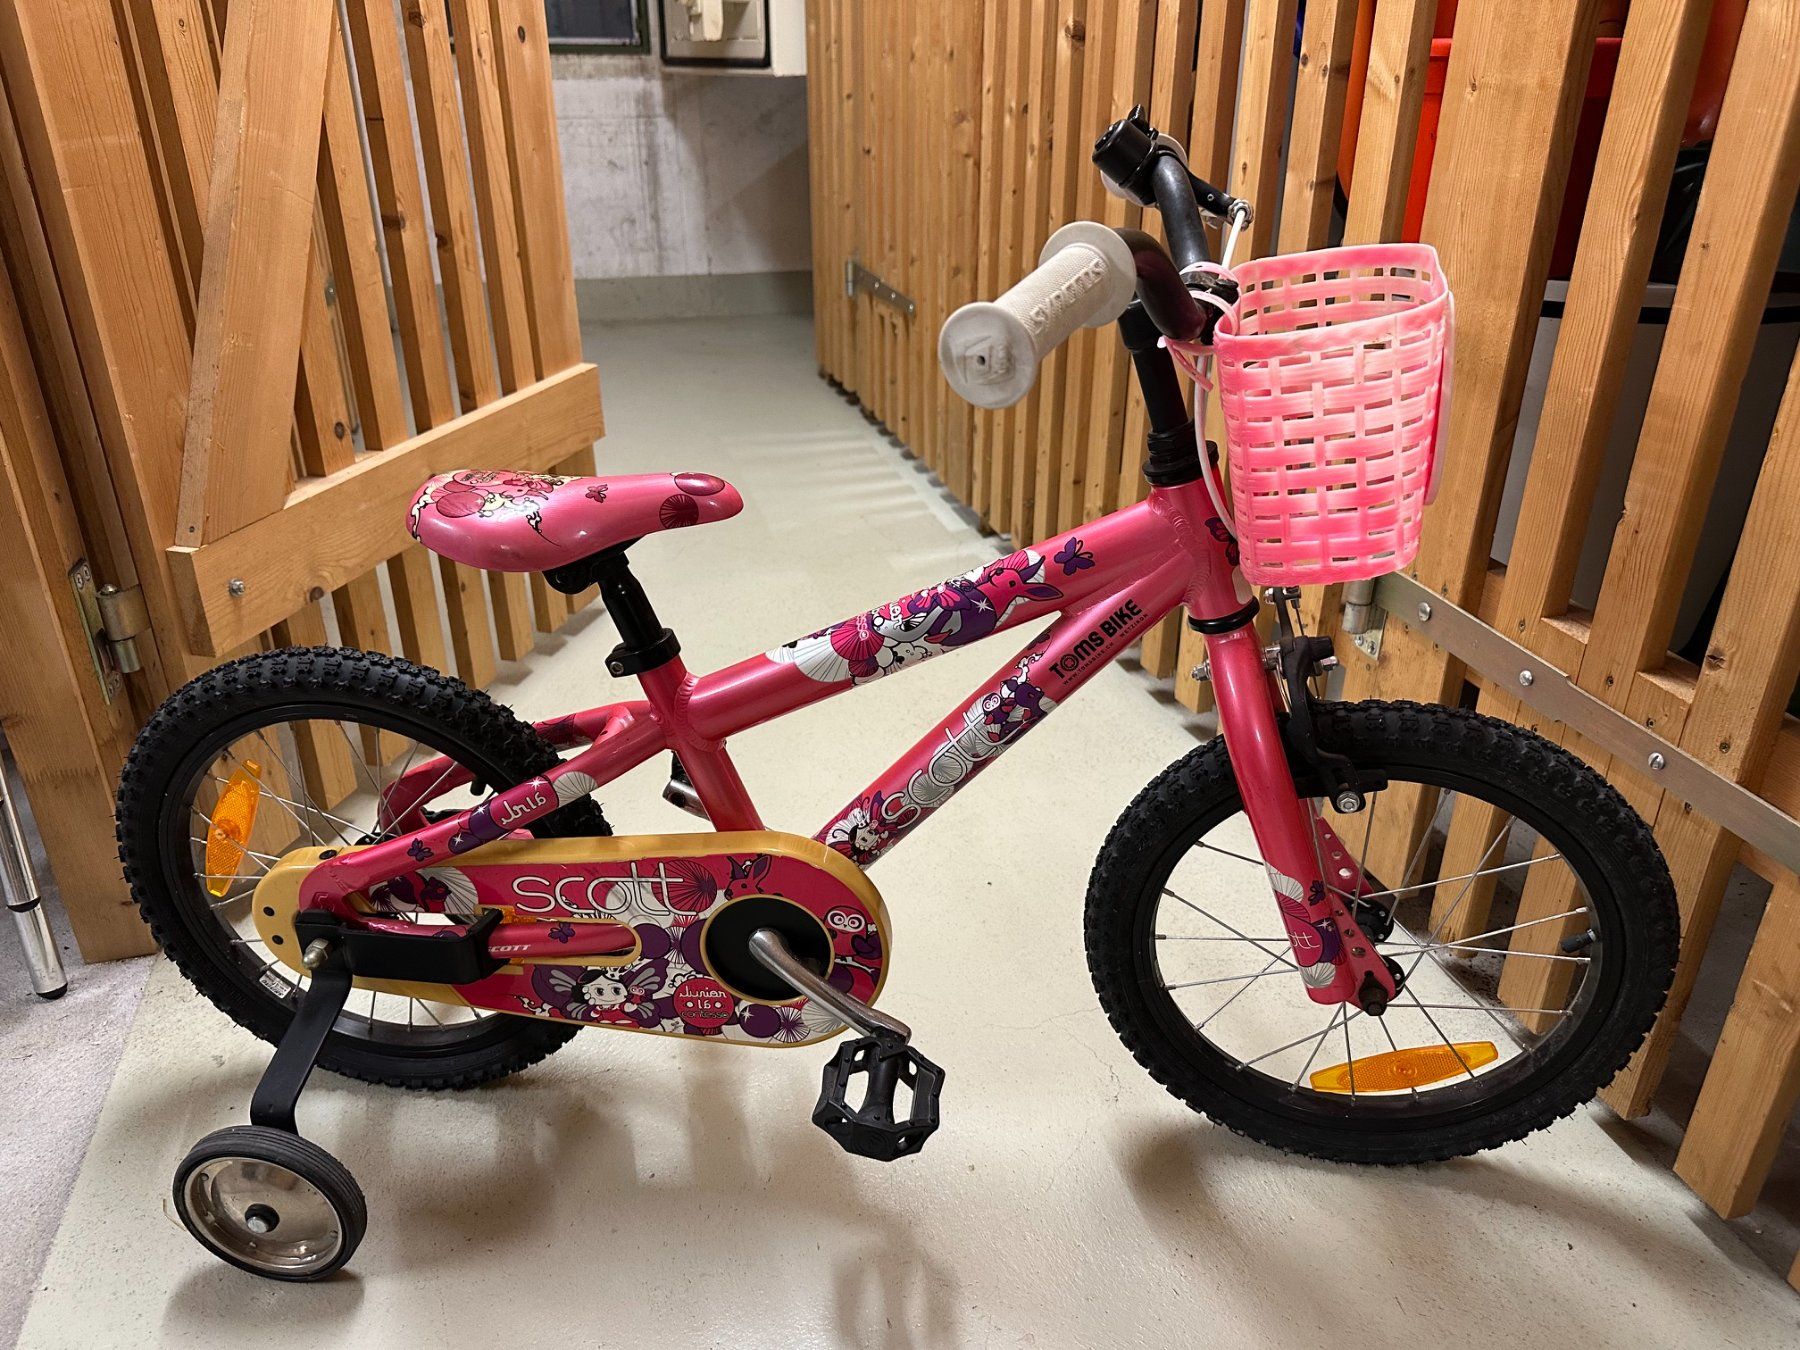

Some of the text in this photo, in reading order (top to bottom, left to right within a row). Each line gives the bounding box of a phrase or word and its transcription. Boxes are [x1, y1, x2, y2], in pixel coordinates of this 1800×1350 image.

[1048, 598, 1142, 679] TOMS BIKE
[881, 711, 1022, 829] scott
[512, 861, 698, 916] scott
[679, 985, 727, 998] Junior
[697, 999, 711, 1009] 16
